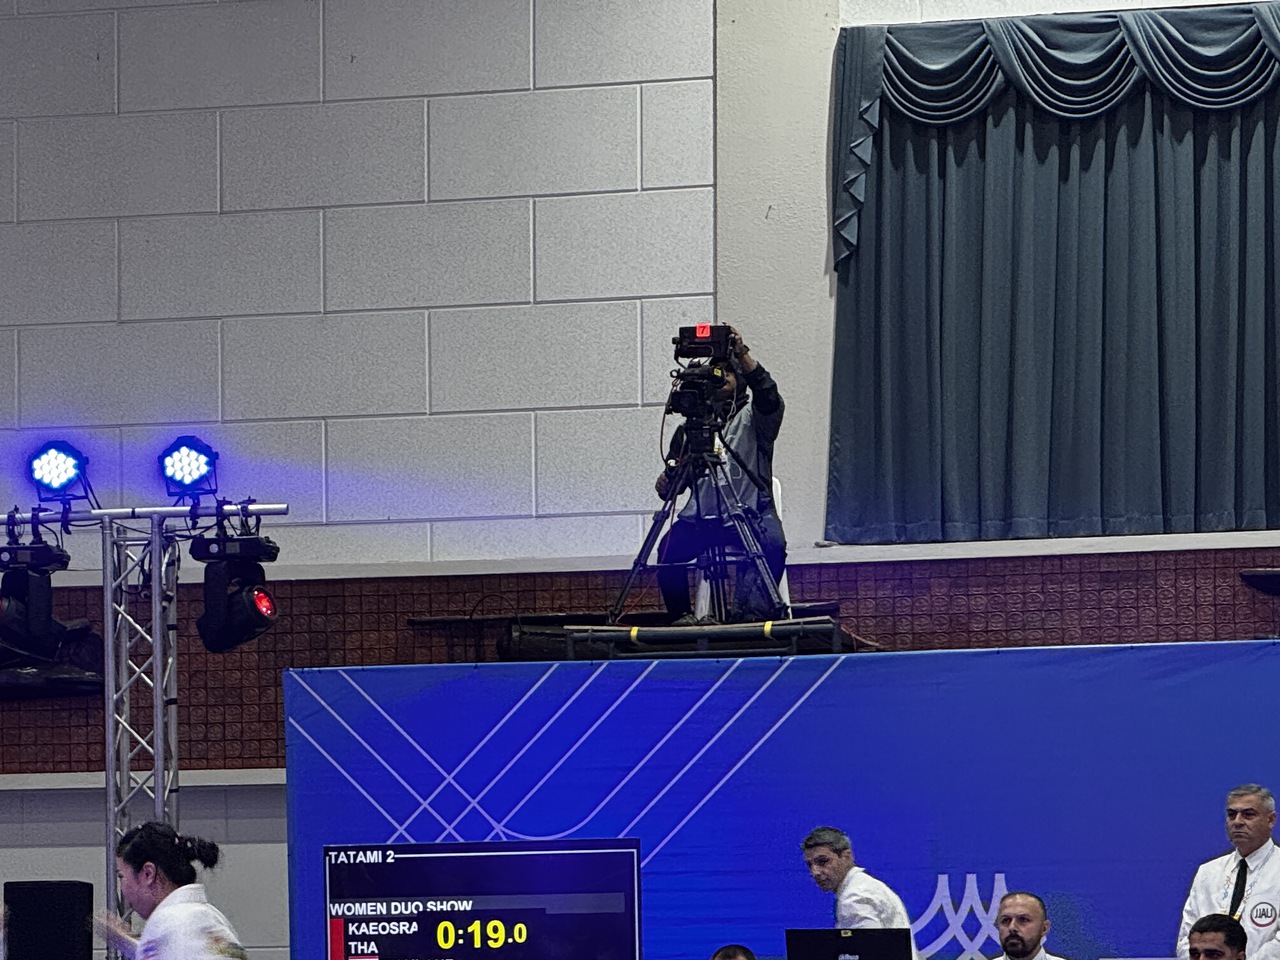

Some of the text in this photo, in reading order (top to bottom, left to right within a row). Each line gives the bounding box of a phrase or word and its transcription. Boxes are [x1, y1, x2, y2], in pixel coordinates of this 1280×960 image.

[328, 850, 395, 864] TATAMI 2
[330, 903, 387, 916] WOMEN
[391, 902, 423, 915] DUO
[348, 941, 378, 954] THA
